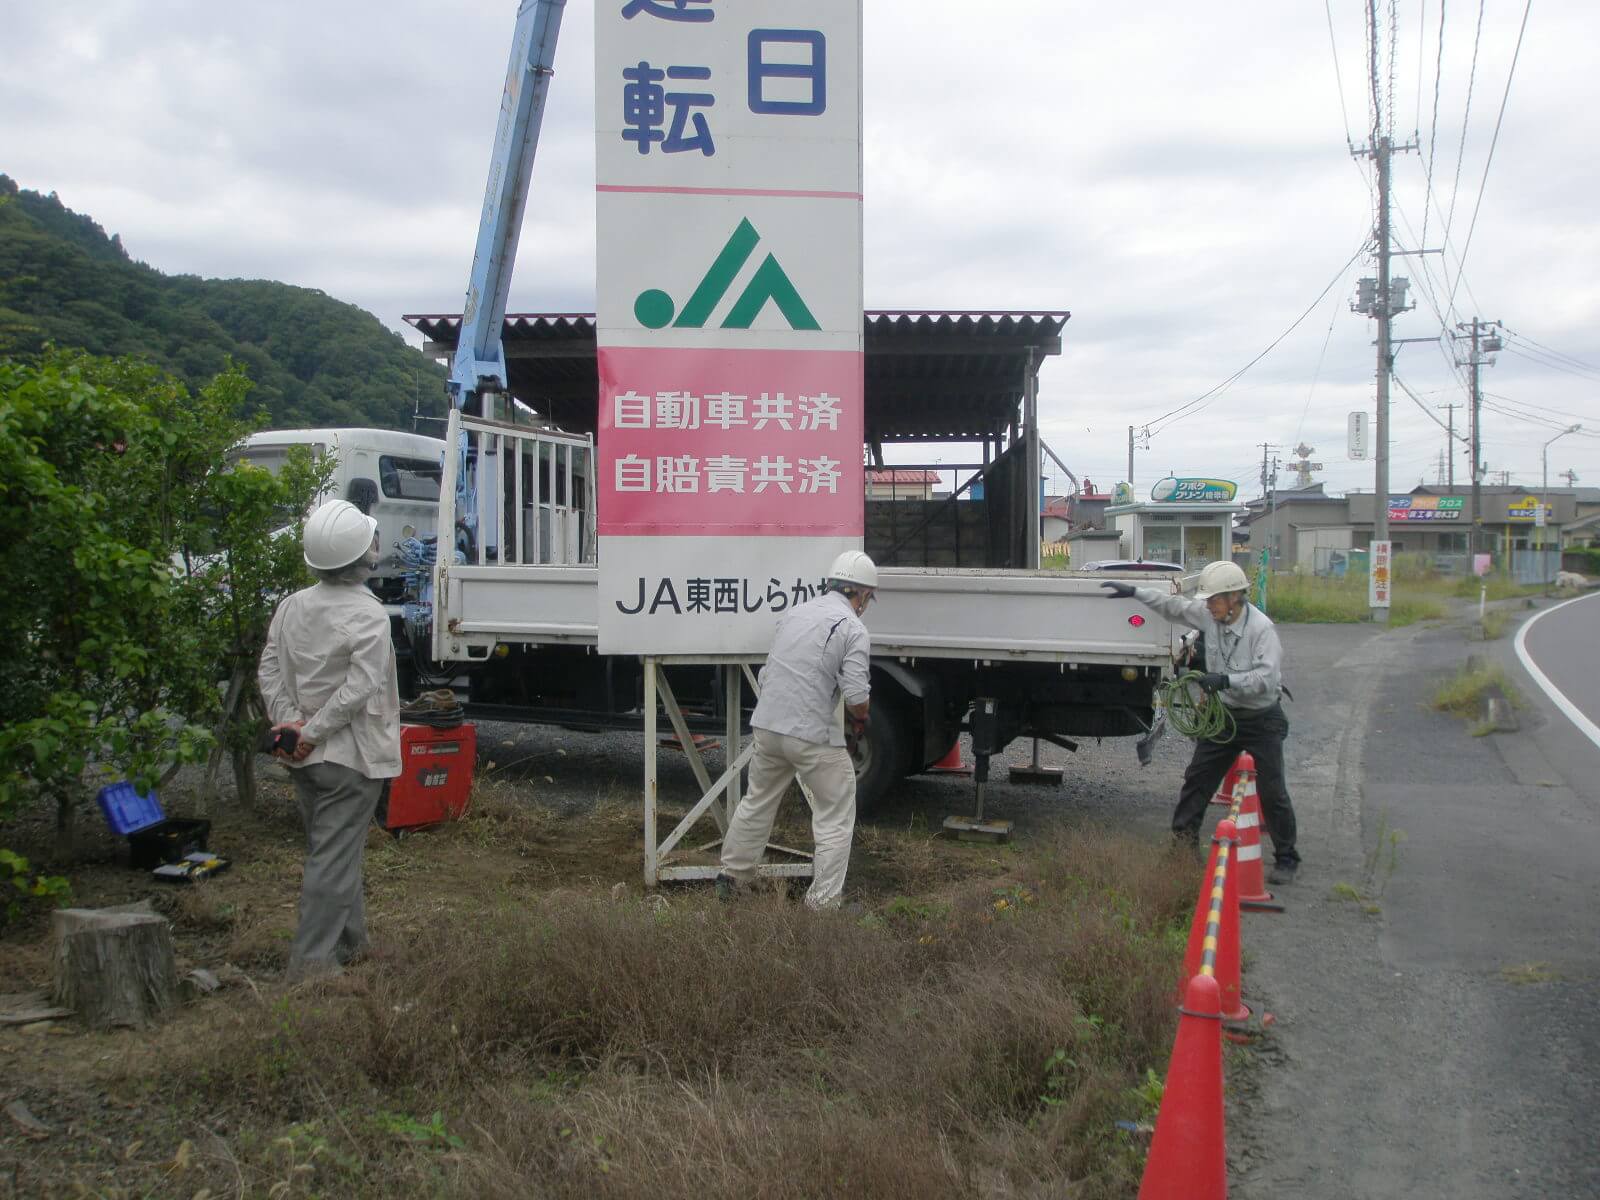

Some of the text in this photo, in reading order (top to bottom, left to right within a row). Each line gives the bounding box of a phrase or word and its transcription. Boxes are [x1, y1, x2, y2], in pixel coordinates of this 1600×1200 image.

[621, 0, 716, 157] 転
[747, 28, 827, 117] 日
[633, 215, 823, 331] JA
[614, 390, 842, 431] 自動車共済
[614, 453, 842, 494] 自賠責共済
[1439, 499, 1463, 507] クロス
